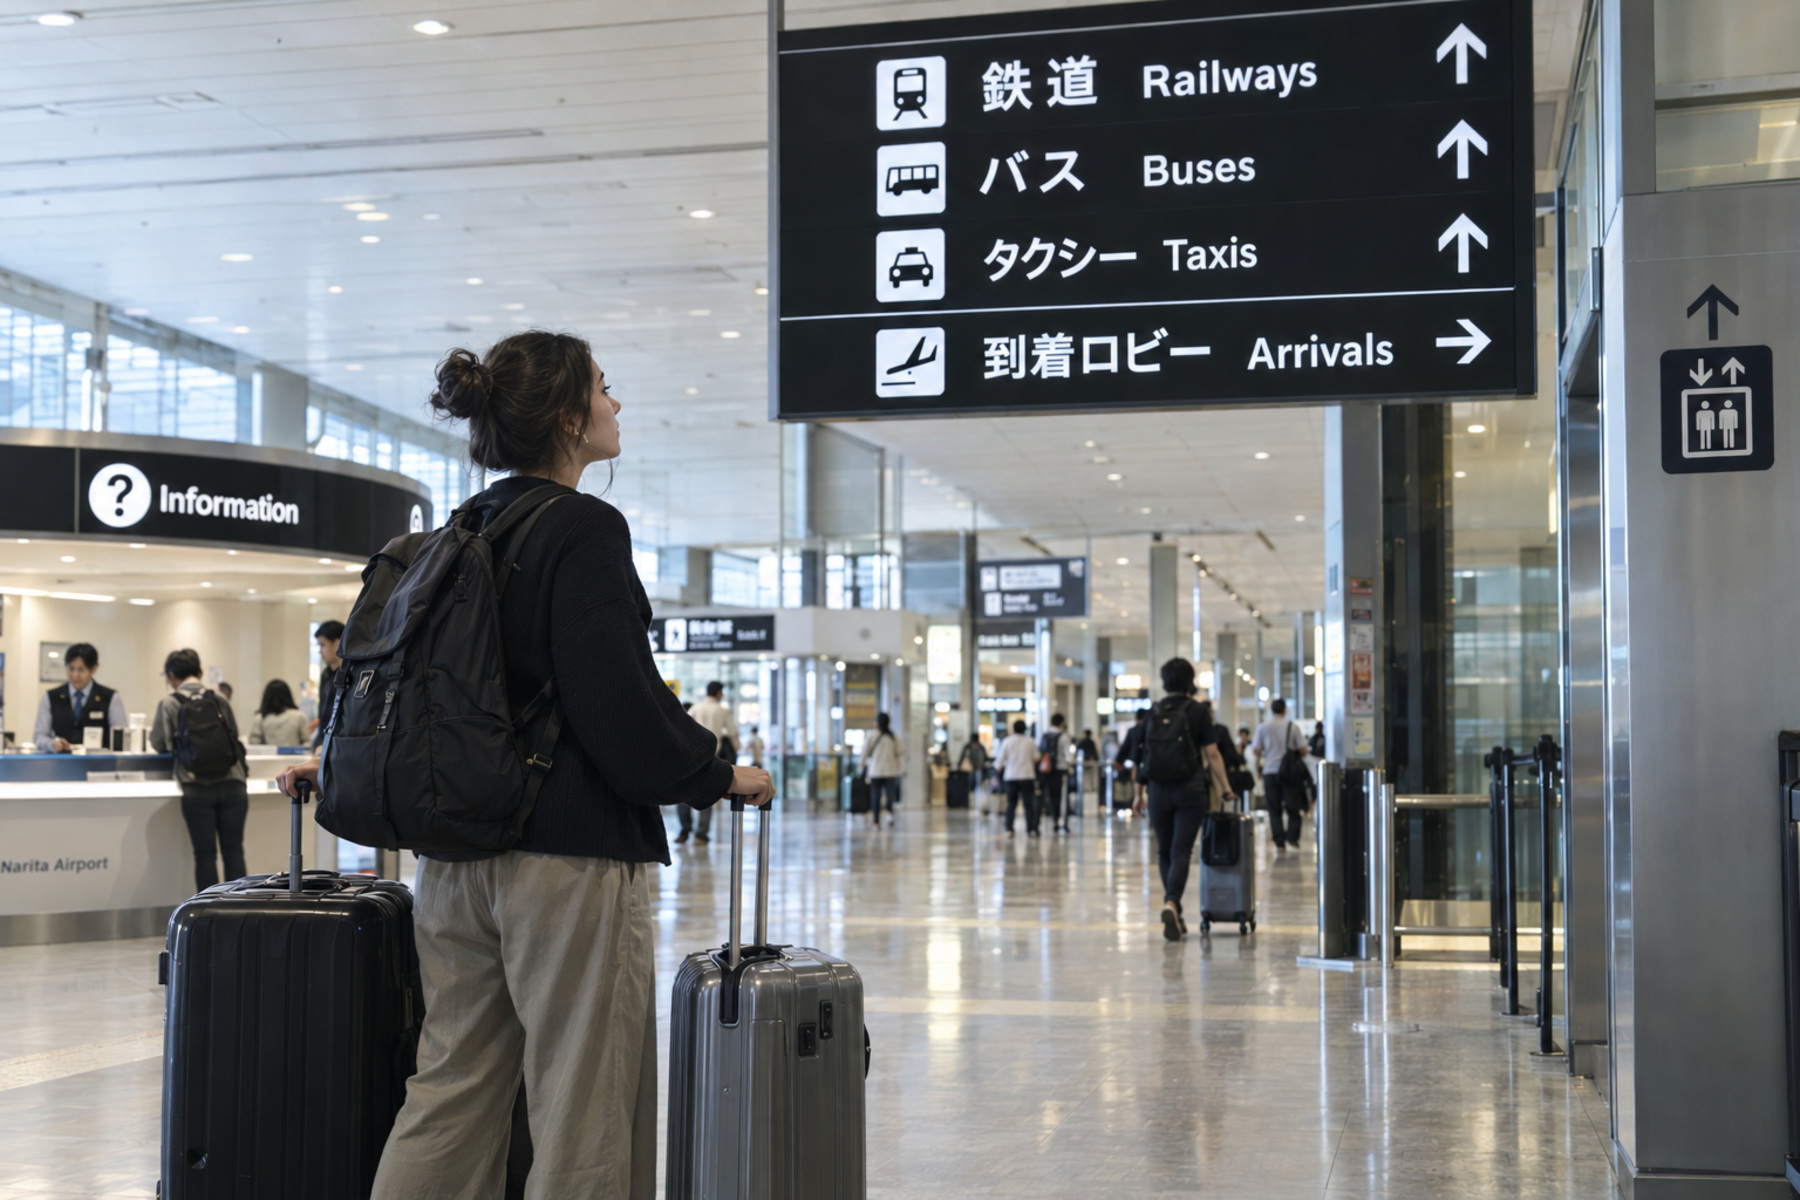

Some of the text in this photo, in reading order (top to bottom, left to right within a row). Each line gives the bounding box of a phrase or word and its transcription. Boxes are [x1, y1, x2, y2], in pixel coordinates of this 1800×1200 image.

[982, 55, 1098, 112] 鉄道
[1143, 60, 1318, 98] Railways
[979, 150, 1085, 195] バス
[1143, 155, 1256, 187] Buses
[983, 236, 1137, 282] タクシー
[1163, 236, 1258, 272] Taxis
[983, 327, 1211, 379] 到着ロビー
[1247, 333, 1394, 370] Arrivals
[159, 484, 300, 525] Information
[0, 857, 109, 874] Narita Airport
